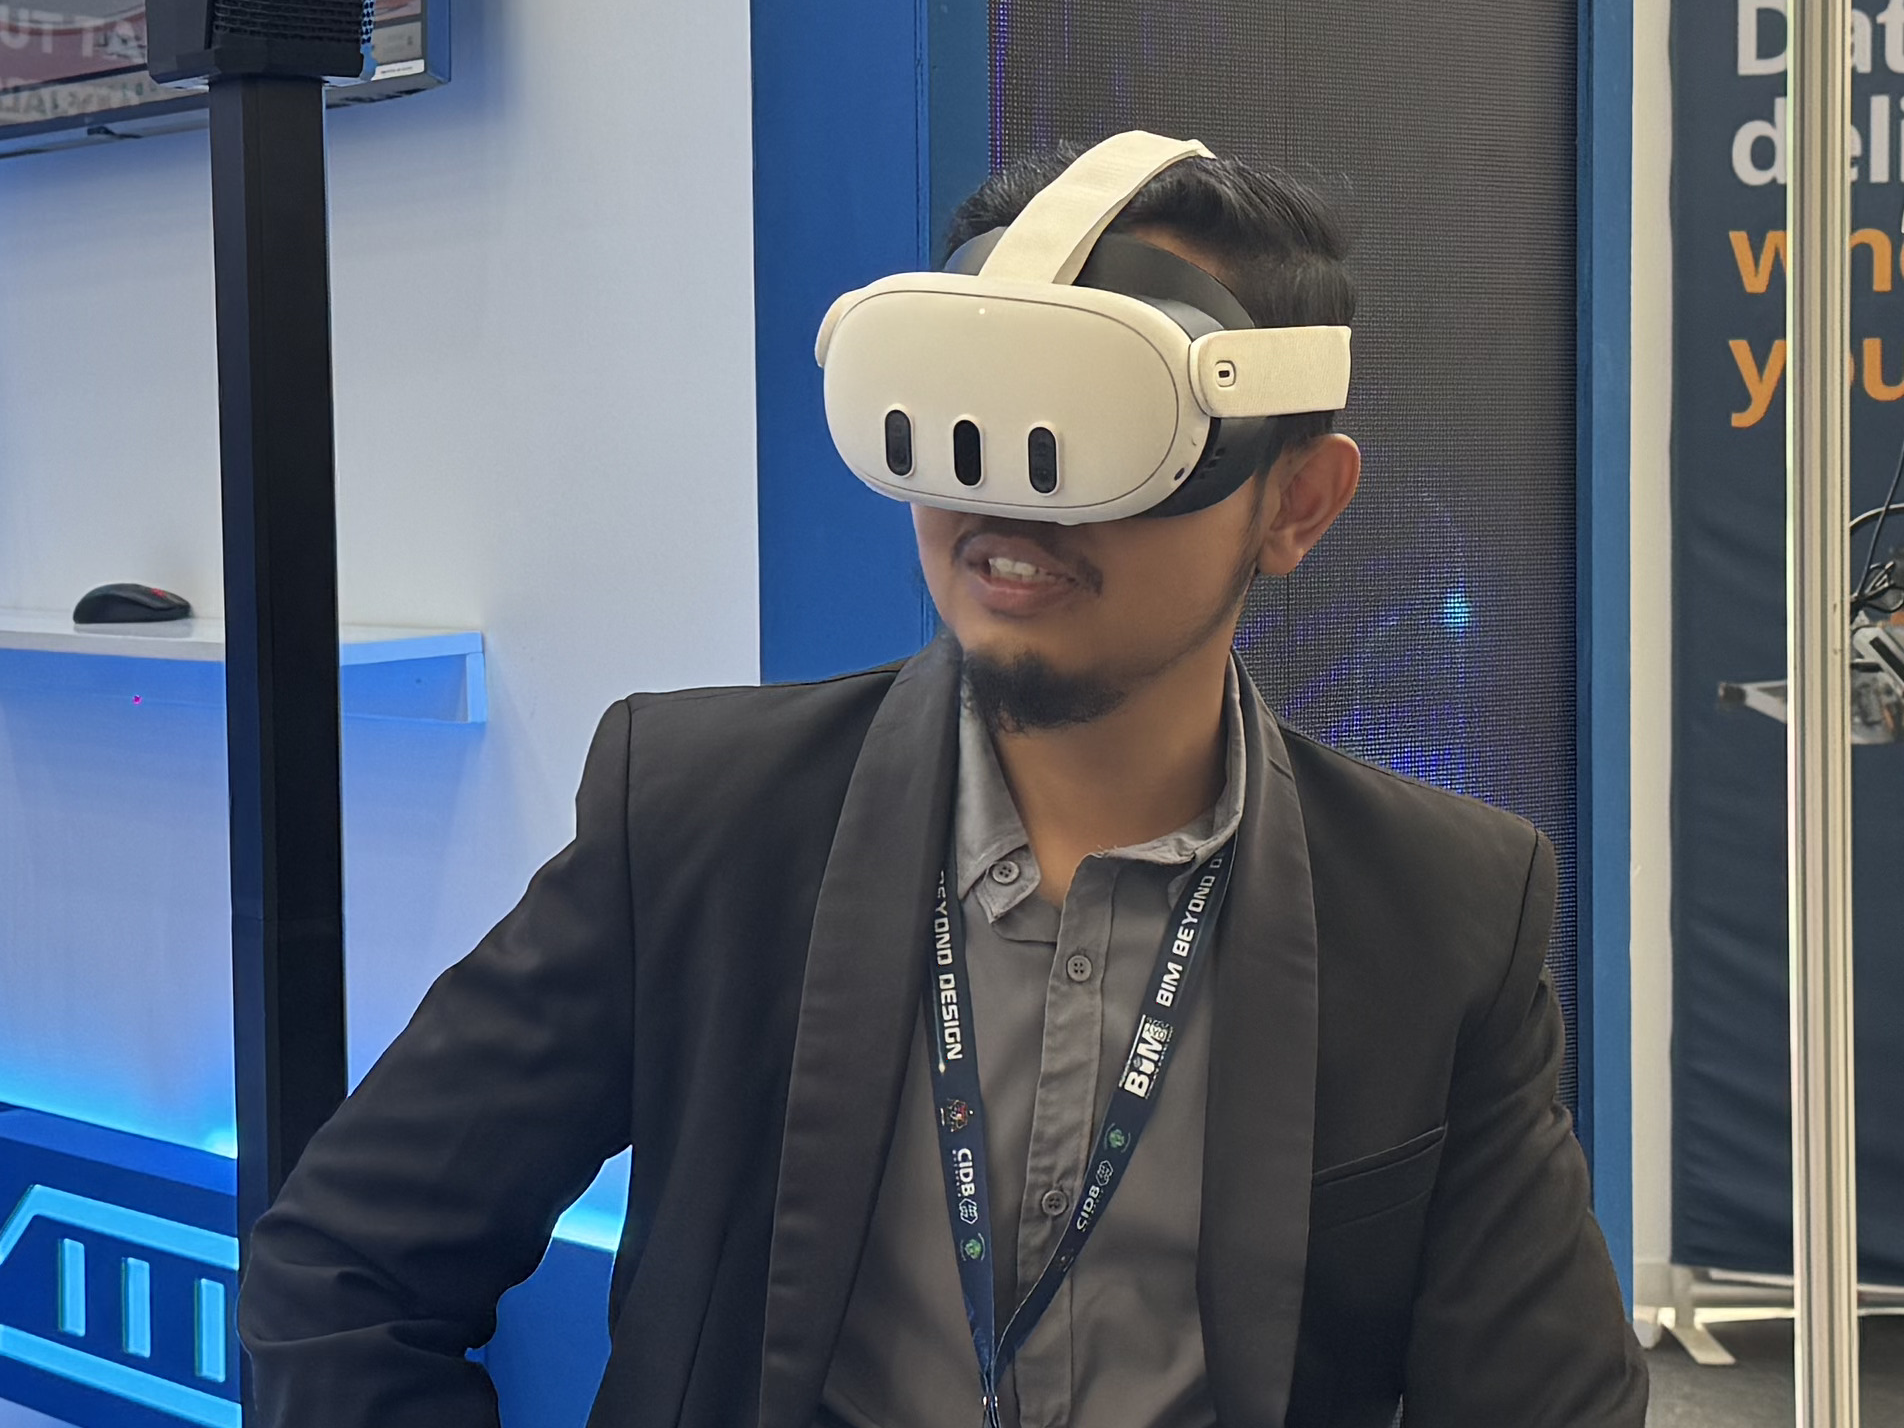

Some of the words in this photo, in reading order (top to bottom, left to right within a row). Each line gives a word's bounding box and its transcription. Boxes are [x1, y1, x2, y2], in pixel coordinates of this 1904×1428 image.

[935, 870, 953, 966] EYOND
[1156, 962, 1183, 1008] BIM
[1172, 875, 1216, 958] BEYOND
[939, 973, 963, 1060] DESIGN
[957, 1148, 976, 1197] CIDB
